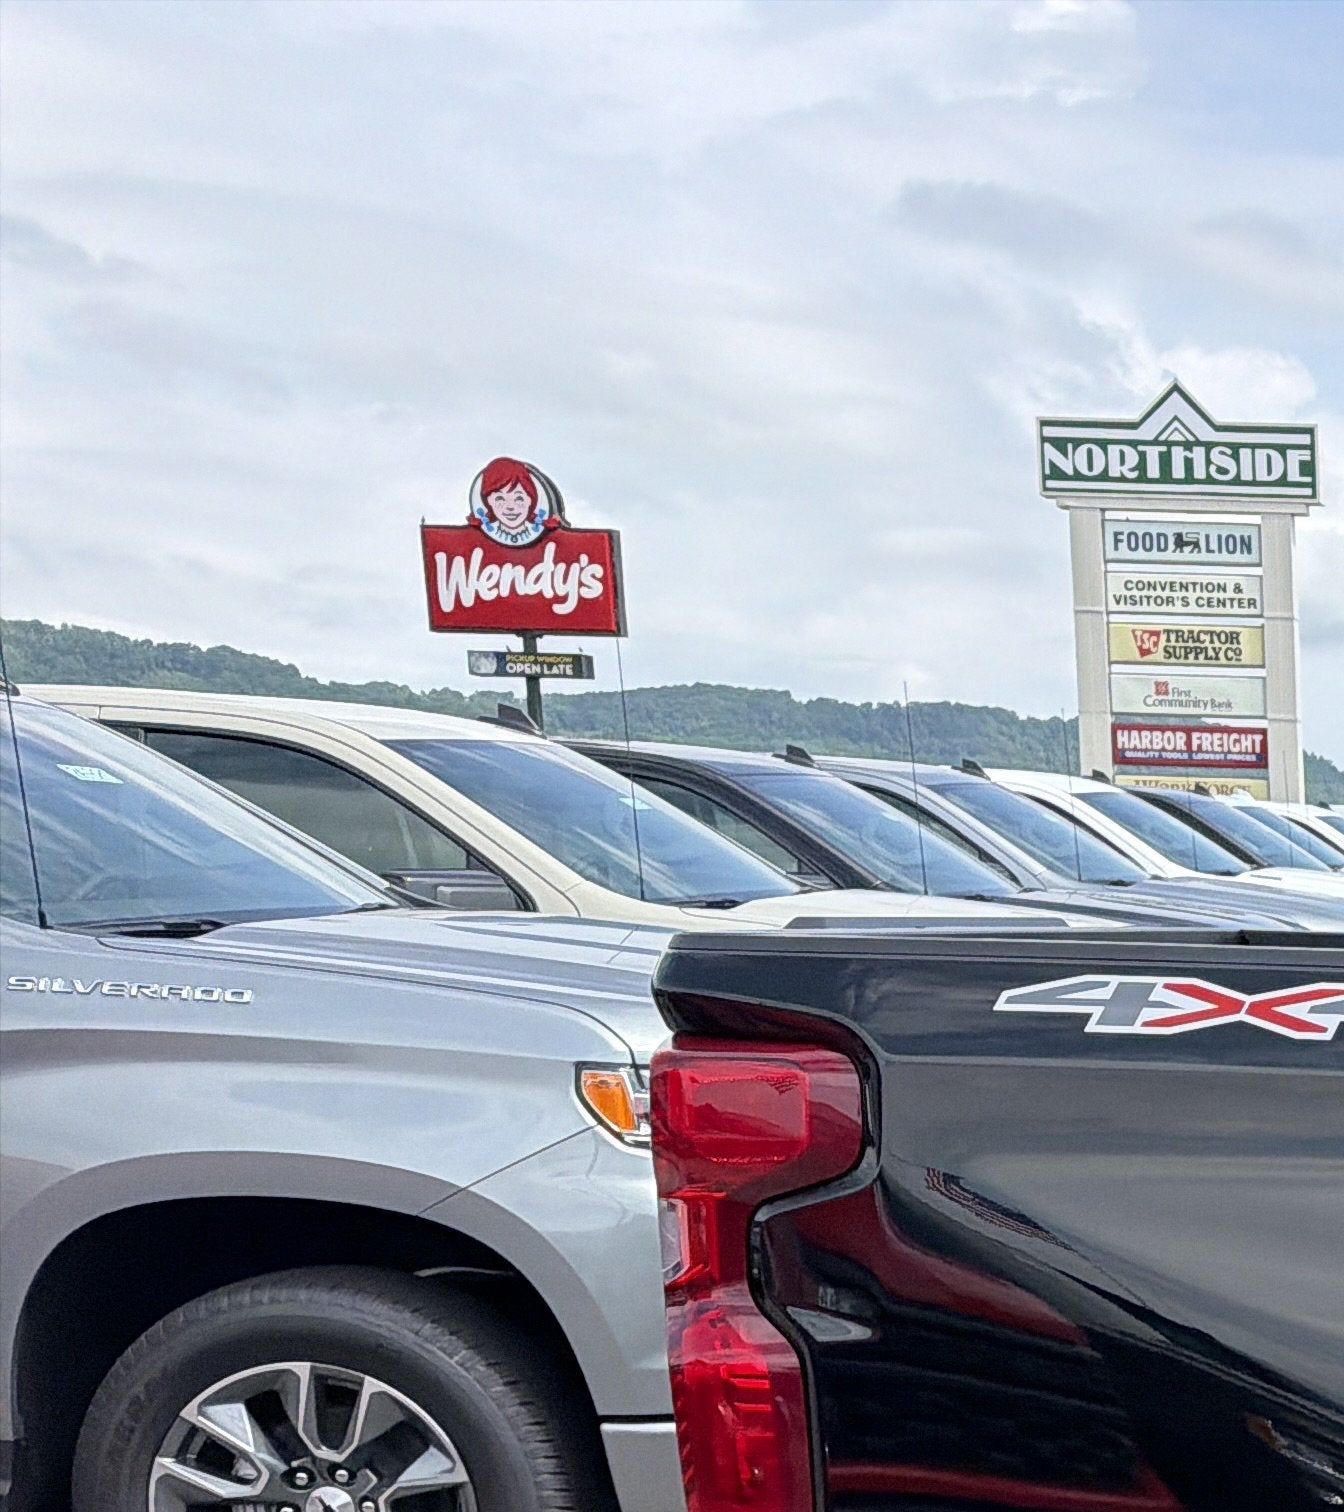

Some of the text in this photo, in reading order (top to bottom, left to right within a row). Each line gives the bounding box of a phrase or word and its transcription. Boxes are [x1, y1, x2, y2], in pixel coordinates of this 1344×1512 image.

[1043, 442, 1313, 483] NORTHSIDE
[1112, 530, 1253, 555] FOOD LION
[434, 541, 604, 616] Wendy's
[1123, 579, 1244, 595] CONVENTION &
[1112, 594, 1258, 610] VISITOR'S CENTER
[1162, 629, 1242, 645] TRACTOR
[1162, 645, 1221, 660] SUPPLY
[505, 662, 574, 676] OPEN LATE
[1171, 687, 1192, 698] First
[1142, 694, 1233, 710] Community Bank
[1116, 729, 1263, 754] HARBOR FREIGHT
[6, 975, 254, 1004] SILVERADO
